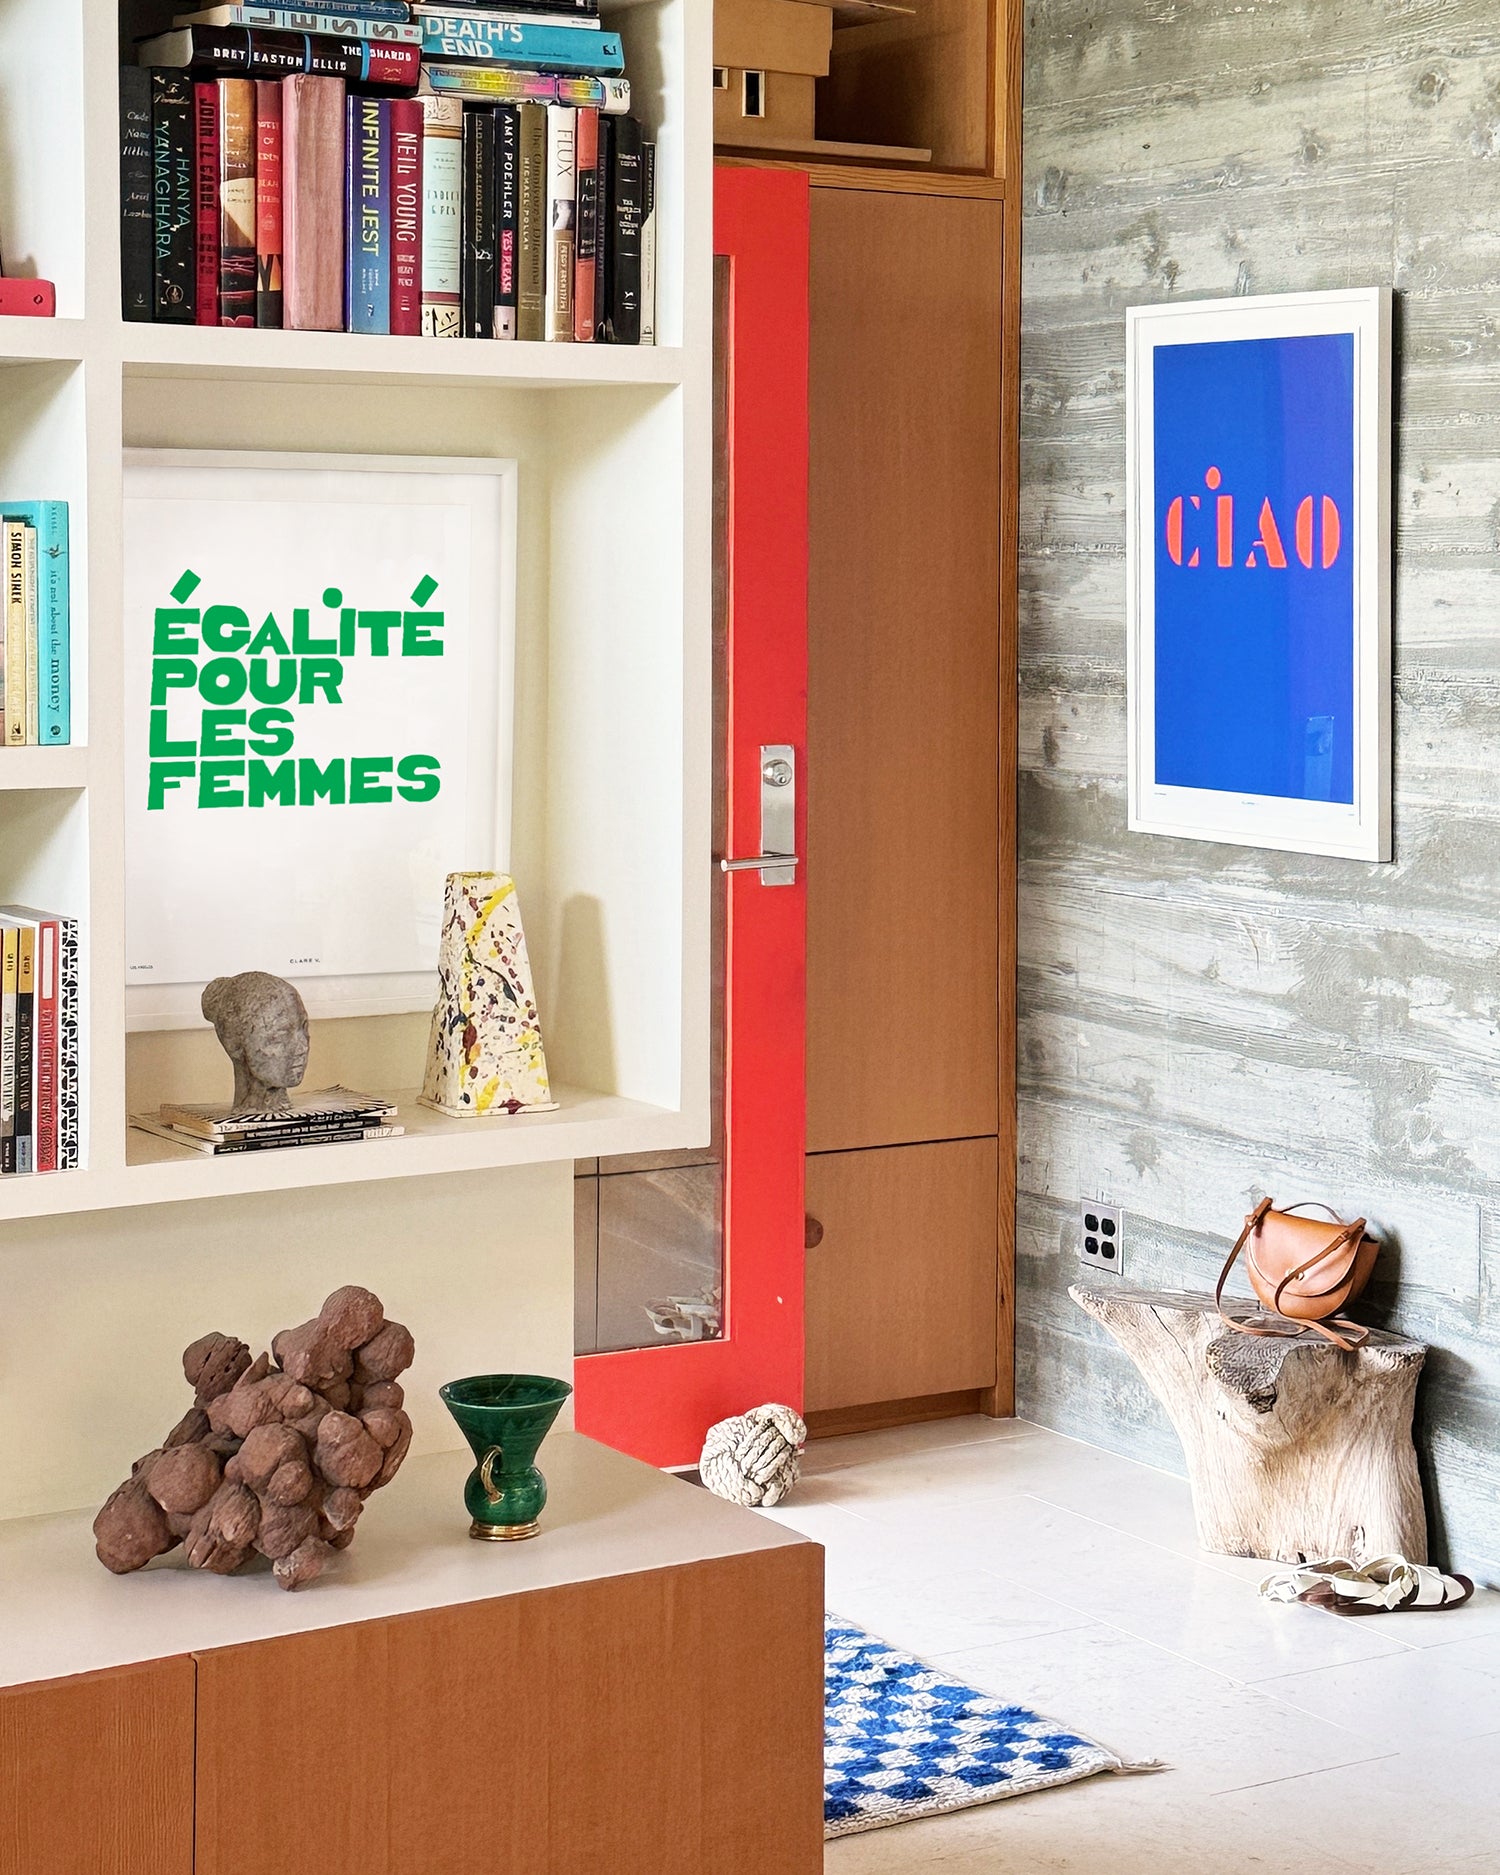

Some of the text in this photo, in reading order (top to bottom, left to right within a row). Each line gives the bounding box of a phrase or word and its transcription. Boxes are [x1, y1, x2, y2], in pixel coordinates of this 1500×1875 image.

[342, 45, 412, 62] THE SHARDS
[426, 17, 524, 43] DEATH'S
[442, 38, 494, 57] END
[214, 48, 346, 71] BRET EASTON ELLIS
[200, 98, 214, 136] JOHN
[503, 115, 514, 219] AMY POEHLER
[556, 130, 573, 177] FLUX
[156, 120, 171, 258] YANAGIHARA
[176, 158, 190, 226] HANYA
[362, 101, 380, 256] INFINITE JEST
[395, 132, 418, 242] NEIL YOUNG
[1166, 466, 1341, 568] CIAO
[10, 532, 22, 568] SIMON
[152, 569, 444, 656] ÉGALITÉ
[48, 660, 60, 712] money
[150, 657, 344, 706] POUR
[149, 708, 294, 758] LES
[147, 754, 441, 810] FEMMES
[4, 1026, 14, 1060] PARIS
[20, 1026, 30, 1061] PARIS
